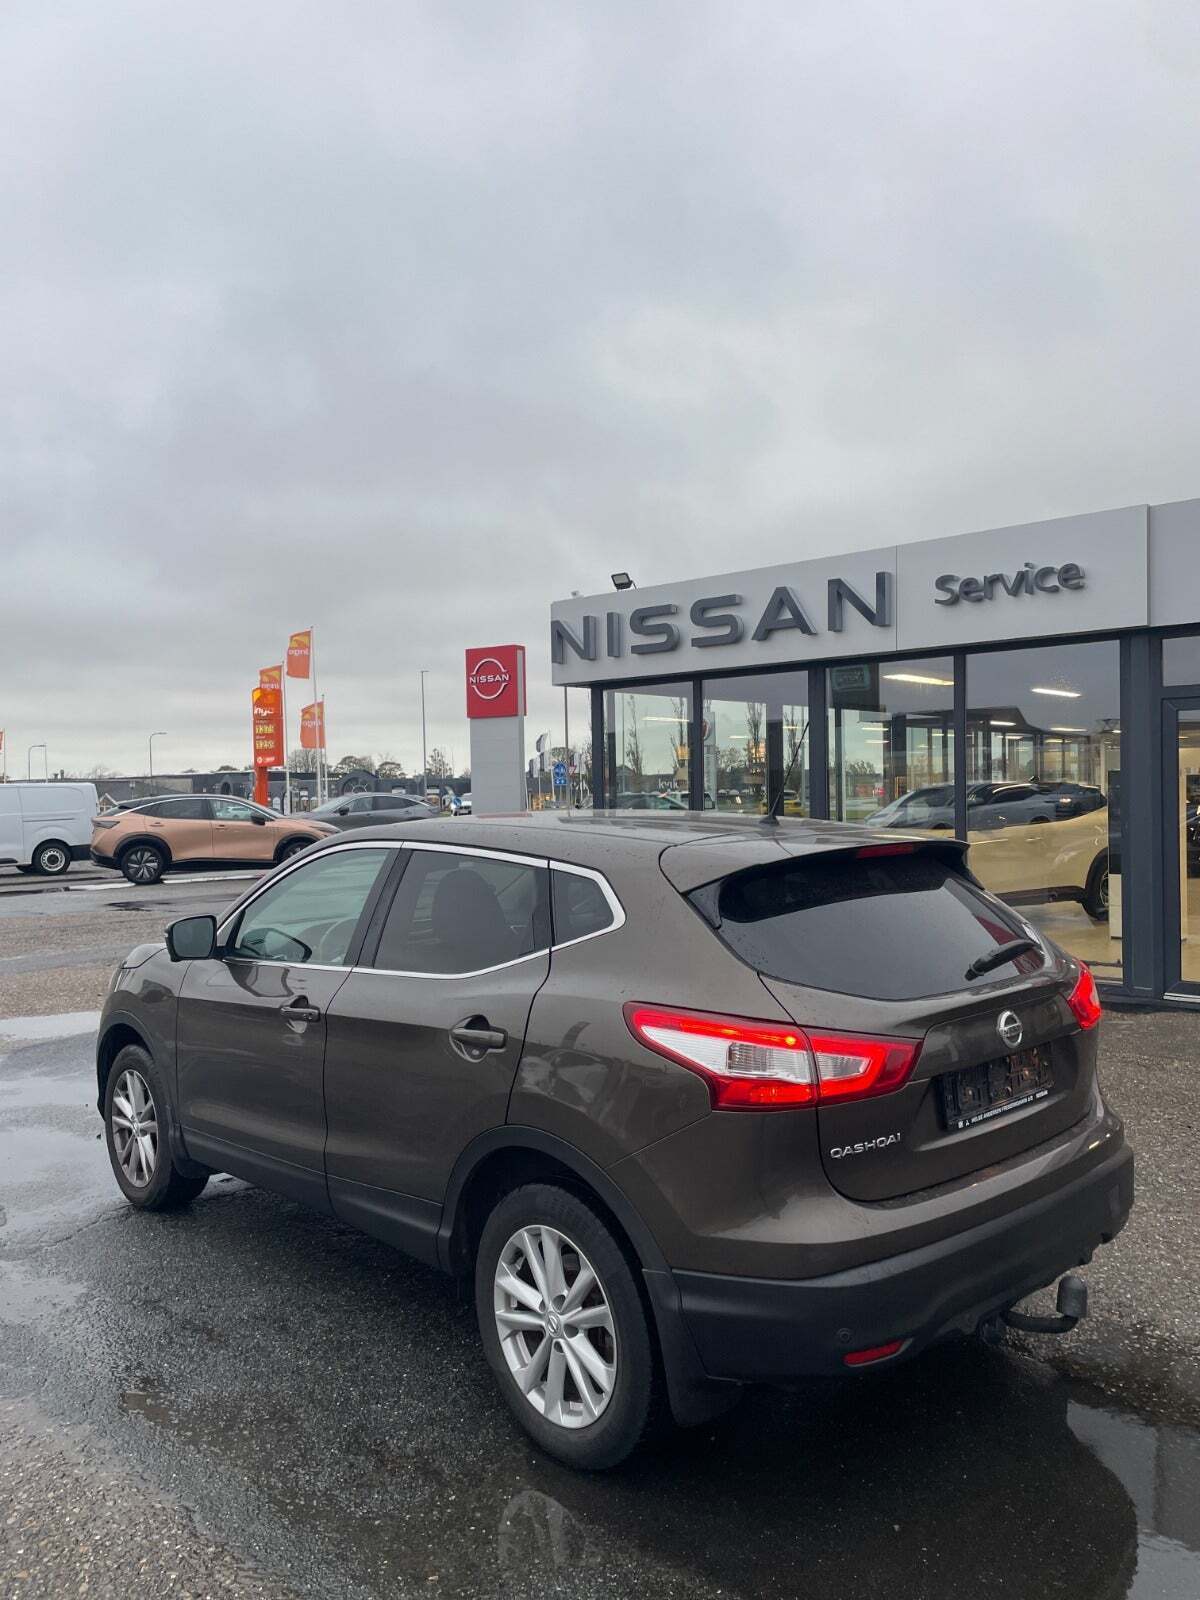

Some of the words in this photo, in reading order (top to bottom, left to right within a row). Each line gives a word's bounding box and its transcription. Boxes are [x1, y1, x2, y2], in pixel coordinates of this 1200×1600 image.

[934, 562, 1086, 606] Service
[550, 571, 893, 665] NISSAN
[470, 674, 509, 684] NISSAN
[830, 1132, 901, 1159] QASHQAI
